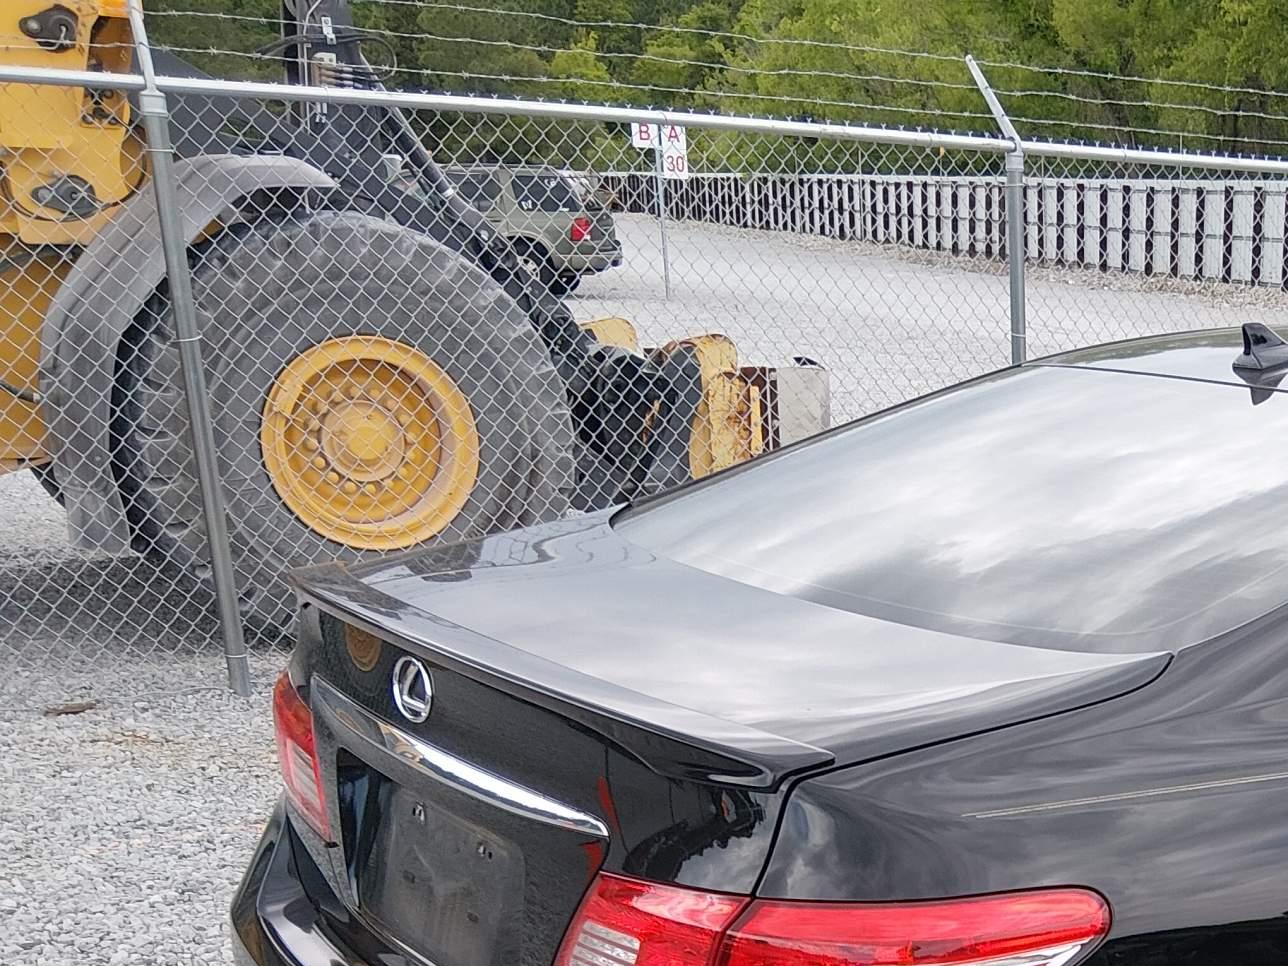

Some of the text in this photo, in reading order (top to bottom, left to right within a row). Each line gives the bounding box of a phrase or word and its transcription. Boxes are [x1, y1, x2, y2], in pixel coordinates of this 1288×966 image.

[640, 123, 650, 140] B
[668, 125, 680, 142] A
[667, 155, 685, 172] 30
